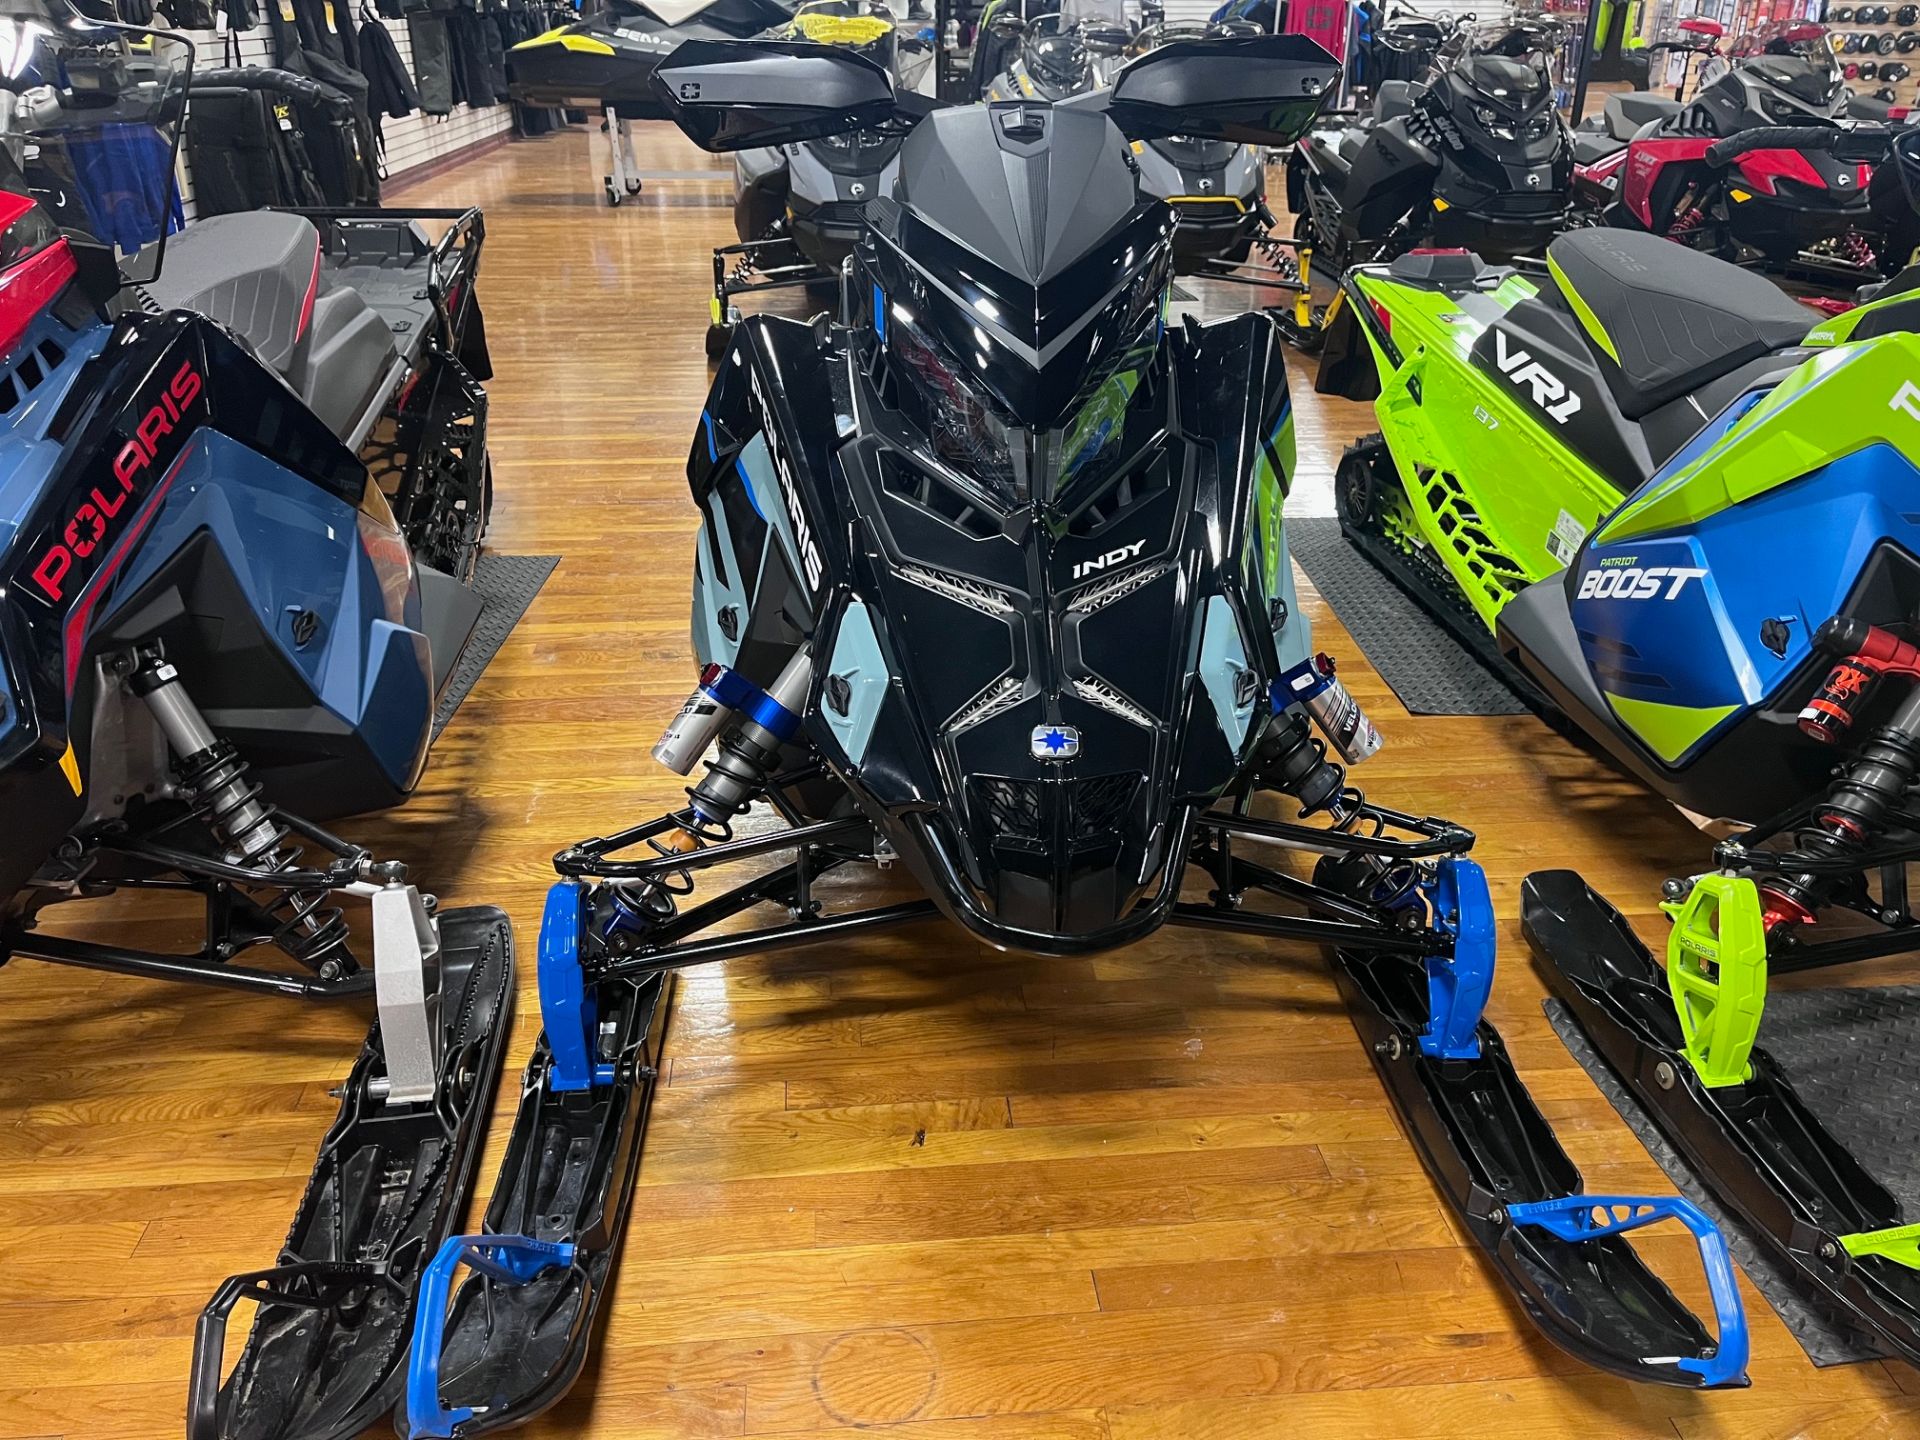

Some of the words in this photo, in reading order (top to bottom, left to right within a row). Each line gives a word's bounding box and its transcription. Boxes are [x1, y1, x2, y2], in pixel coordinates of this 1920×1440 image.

[1496, 329, 1581, 425] VR1
[1472, 404, 1499, 430] 137
[32, 360, 202, 602] POLARIS
[751, 362, 823, 592] POLARIS
[1073, 539, 1146, 579] INDY
[1600, 556, 1638, 567] PATRIOT
[1577, 568, 1708, 600] BOOST
[1343, 701, 1358, 732] VELO
[1680, 935, 1717, 958] POLARIS
